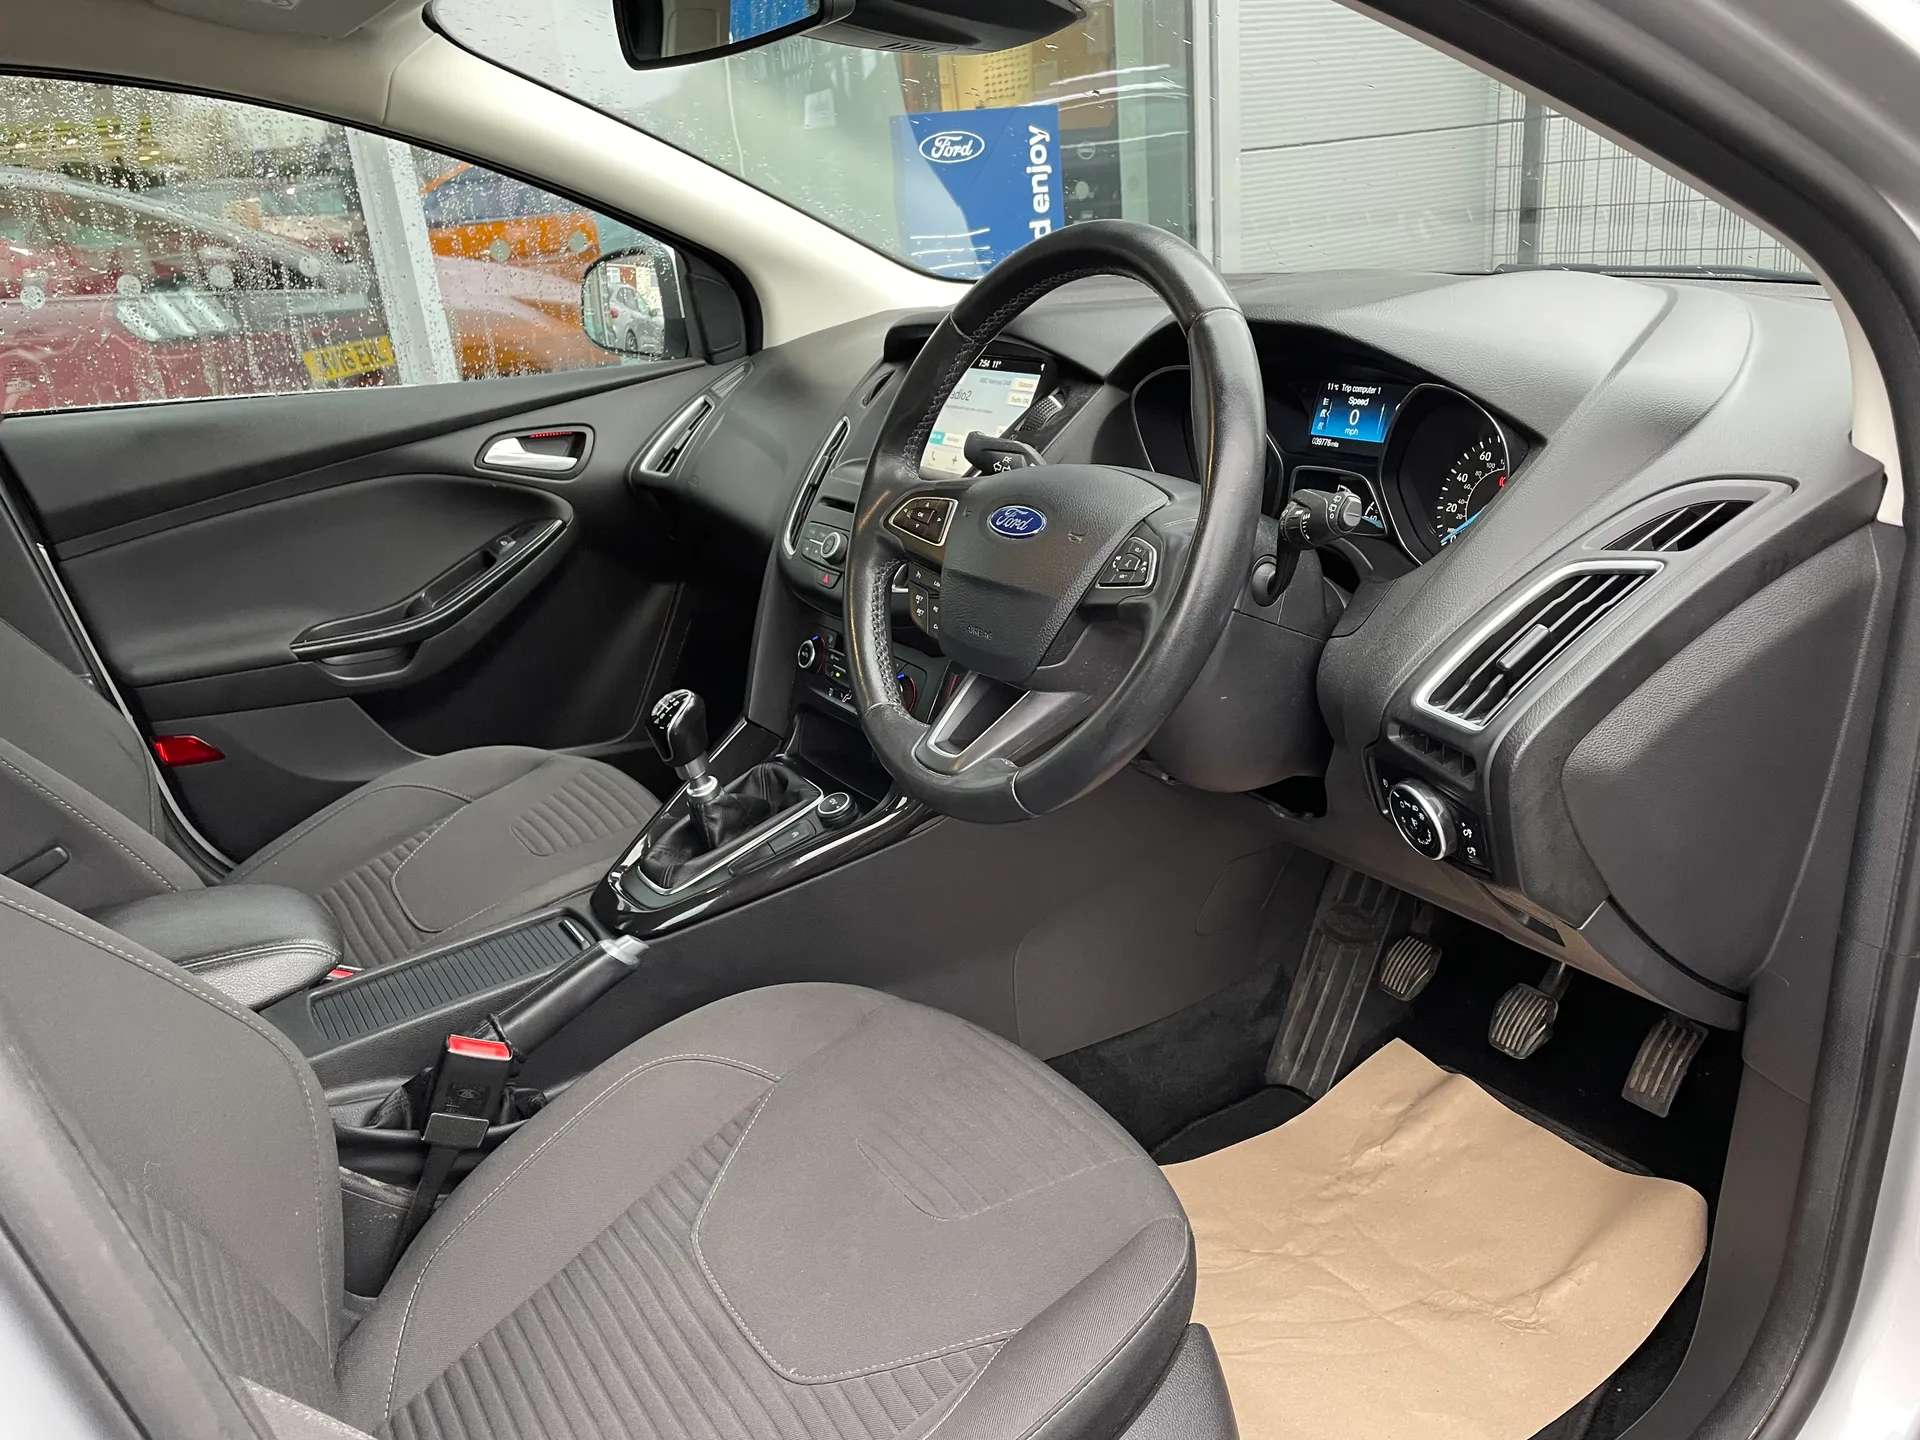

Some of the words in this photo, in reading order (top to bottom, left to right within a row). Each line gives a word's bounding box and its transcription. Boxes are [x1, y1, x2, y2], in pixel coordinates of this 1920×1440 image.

[931, 135, 973, 158] Ford
[1026, 125, 1052, 213] enjoy
[1029, 219, 1051, 240] d
[951, 389, 973, 401] adio2
[1341, 383, 1352, 393] Trip
[1352, 386, 1376, 395] computer
[1348, 396, 1370, 406] Speed
[1349, 409, 1360, 426] 0
[1344, 428, 1359, 436] mph
[1479, 451, 1492, 461] 60
[1456, 472, 1468, 483] 40
[1446, 502, 1458, 513] 20
[996, 506, 1034, 531] Ford
